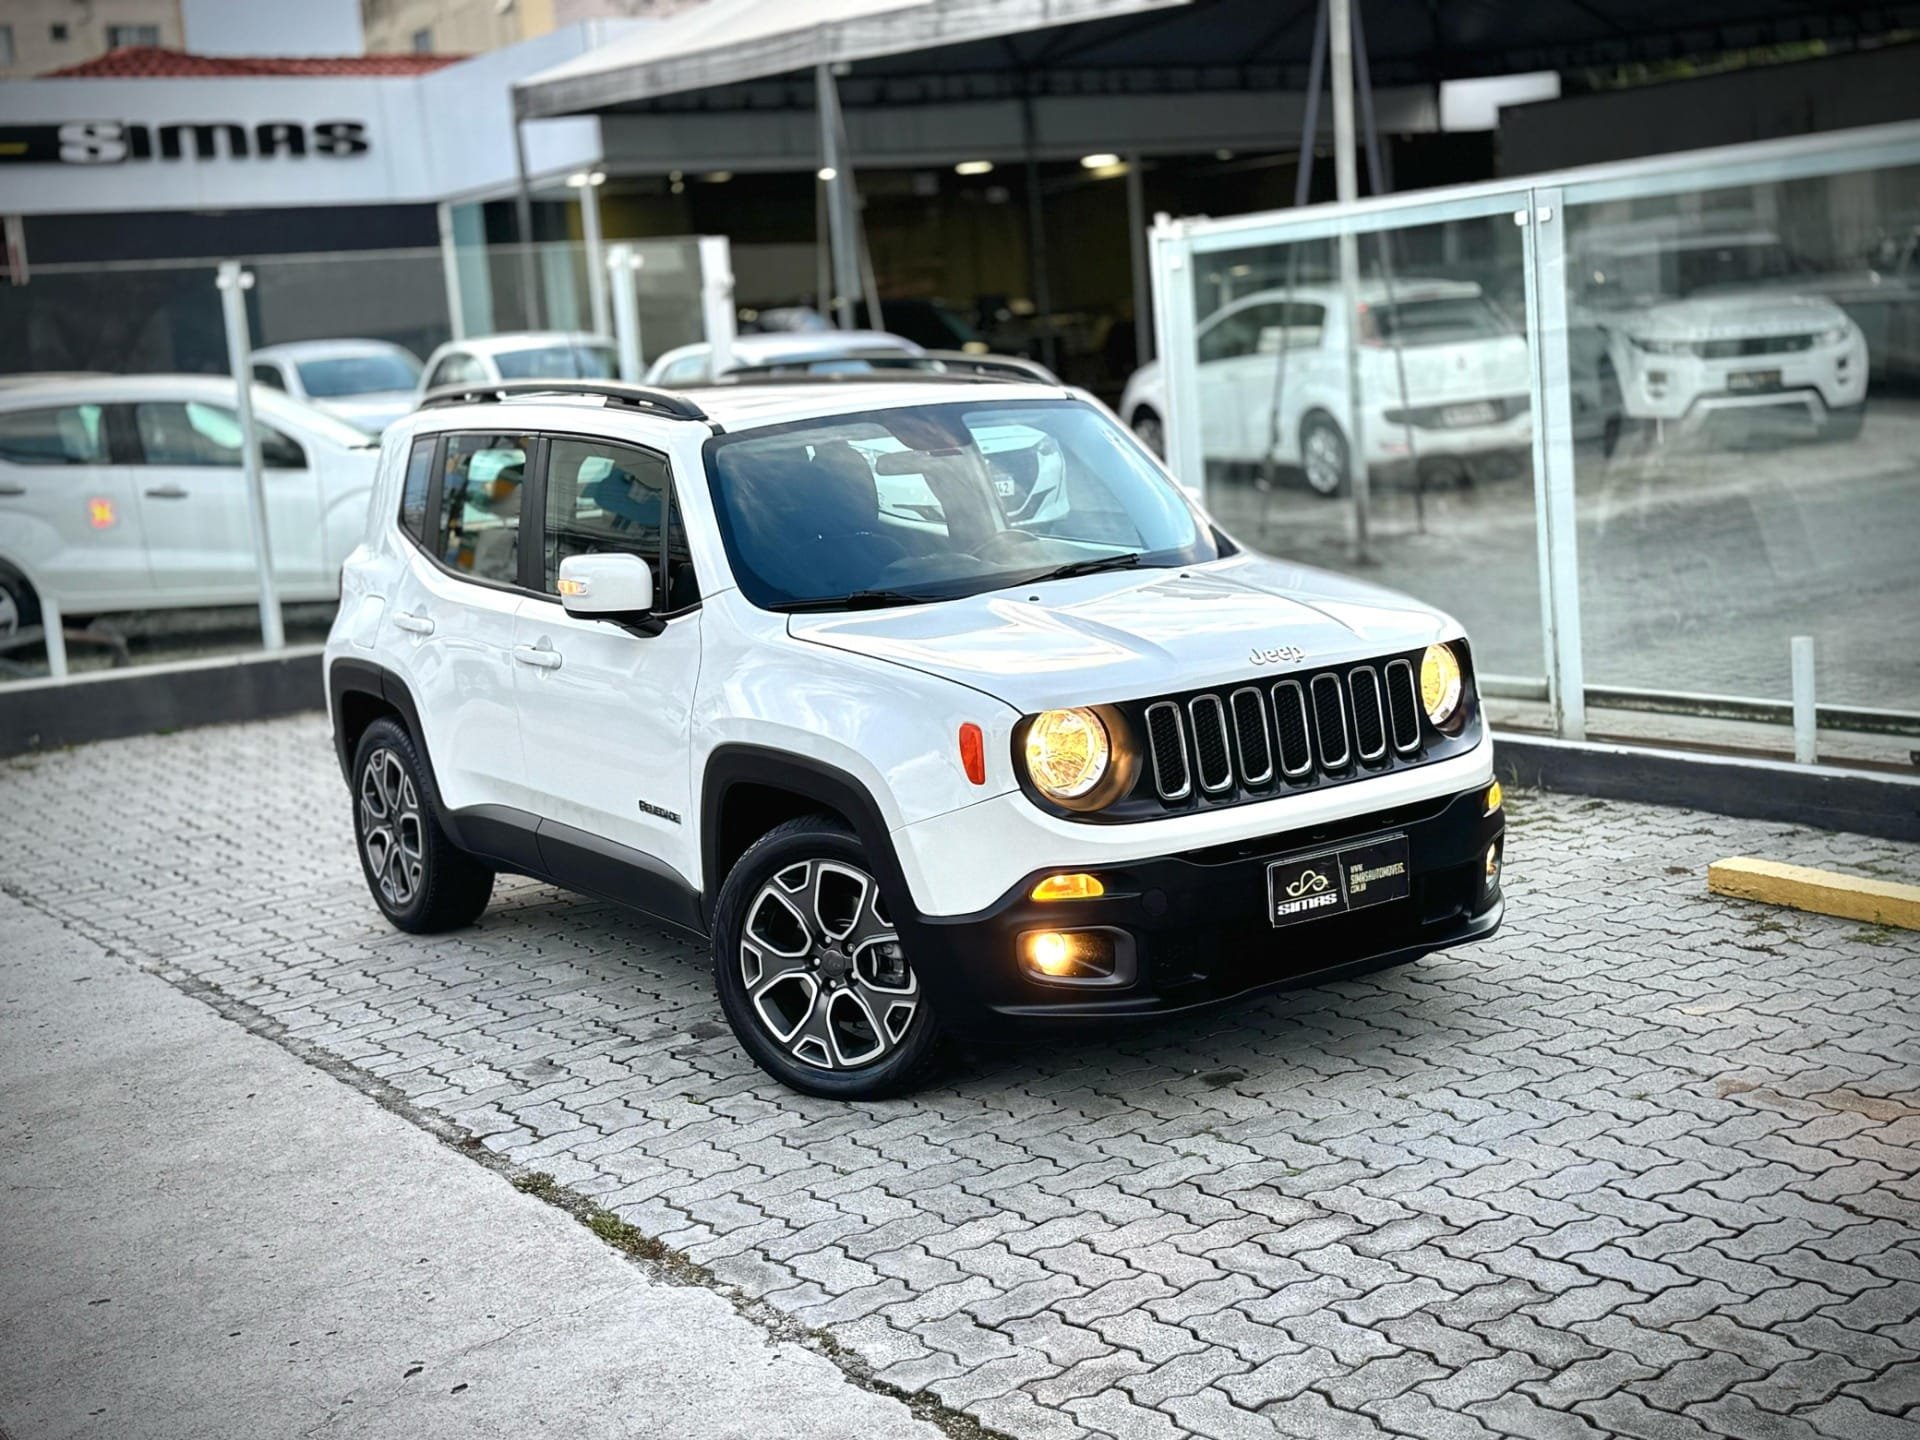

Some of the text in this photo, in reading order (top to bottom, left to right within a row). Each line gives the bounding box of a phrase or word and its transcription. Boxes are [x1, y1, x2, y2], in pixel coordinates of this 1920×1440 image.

[58, 119, 369, 164] SIMAS
[1248, 645, 1305, 666] Jeep
[1277, 893, 1338, 915] SIMAS
